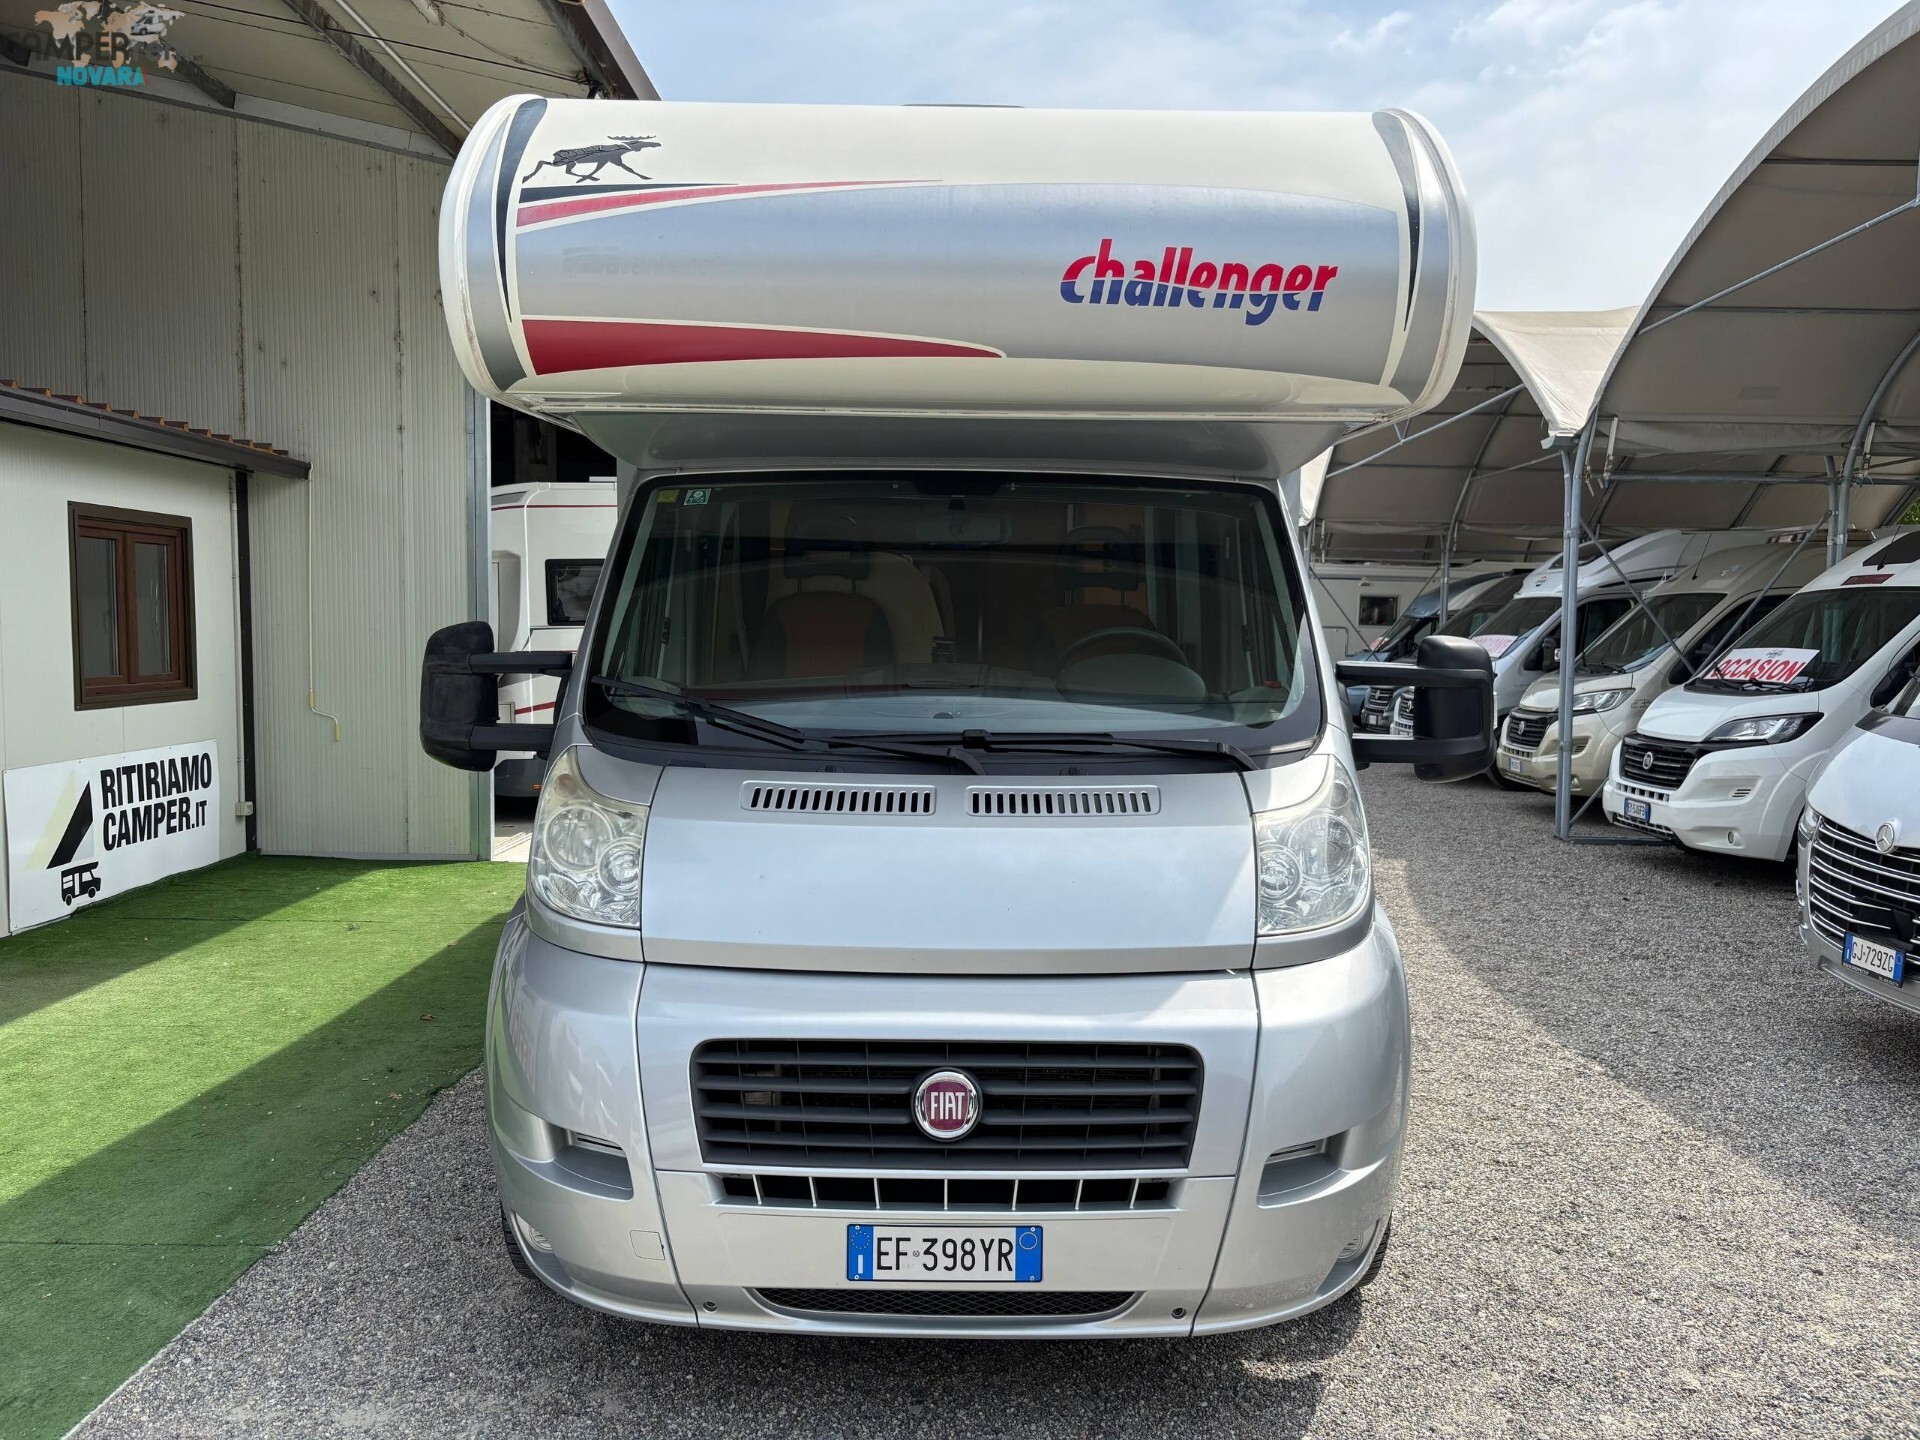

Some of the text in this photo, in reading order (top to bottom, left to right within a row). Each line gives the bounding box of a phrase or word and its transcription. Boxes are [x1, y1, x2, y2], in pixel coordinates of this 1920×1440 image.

[1060, 238, 1338, 326] challenger
[1711, 659, 1806, 682] OCCASION
[100, 752, 212, 810] RITIRIAMO
[103, 796, 207, 851] CAMPER.IT
[930, 1091, 965, 1120] FIAT
[876, 1237, 1014, 1272] EF 398YR
